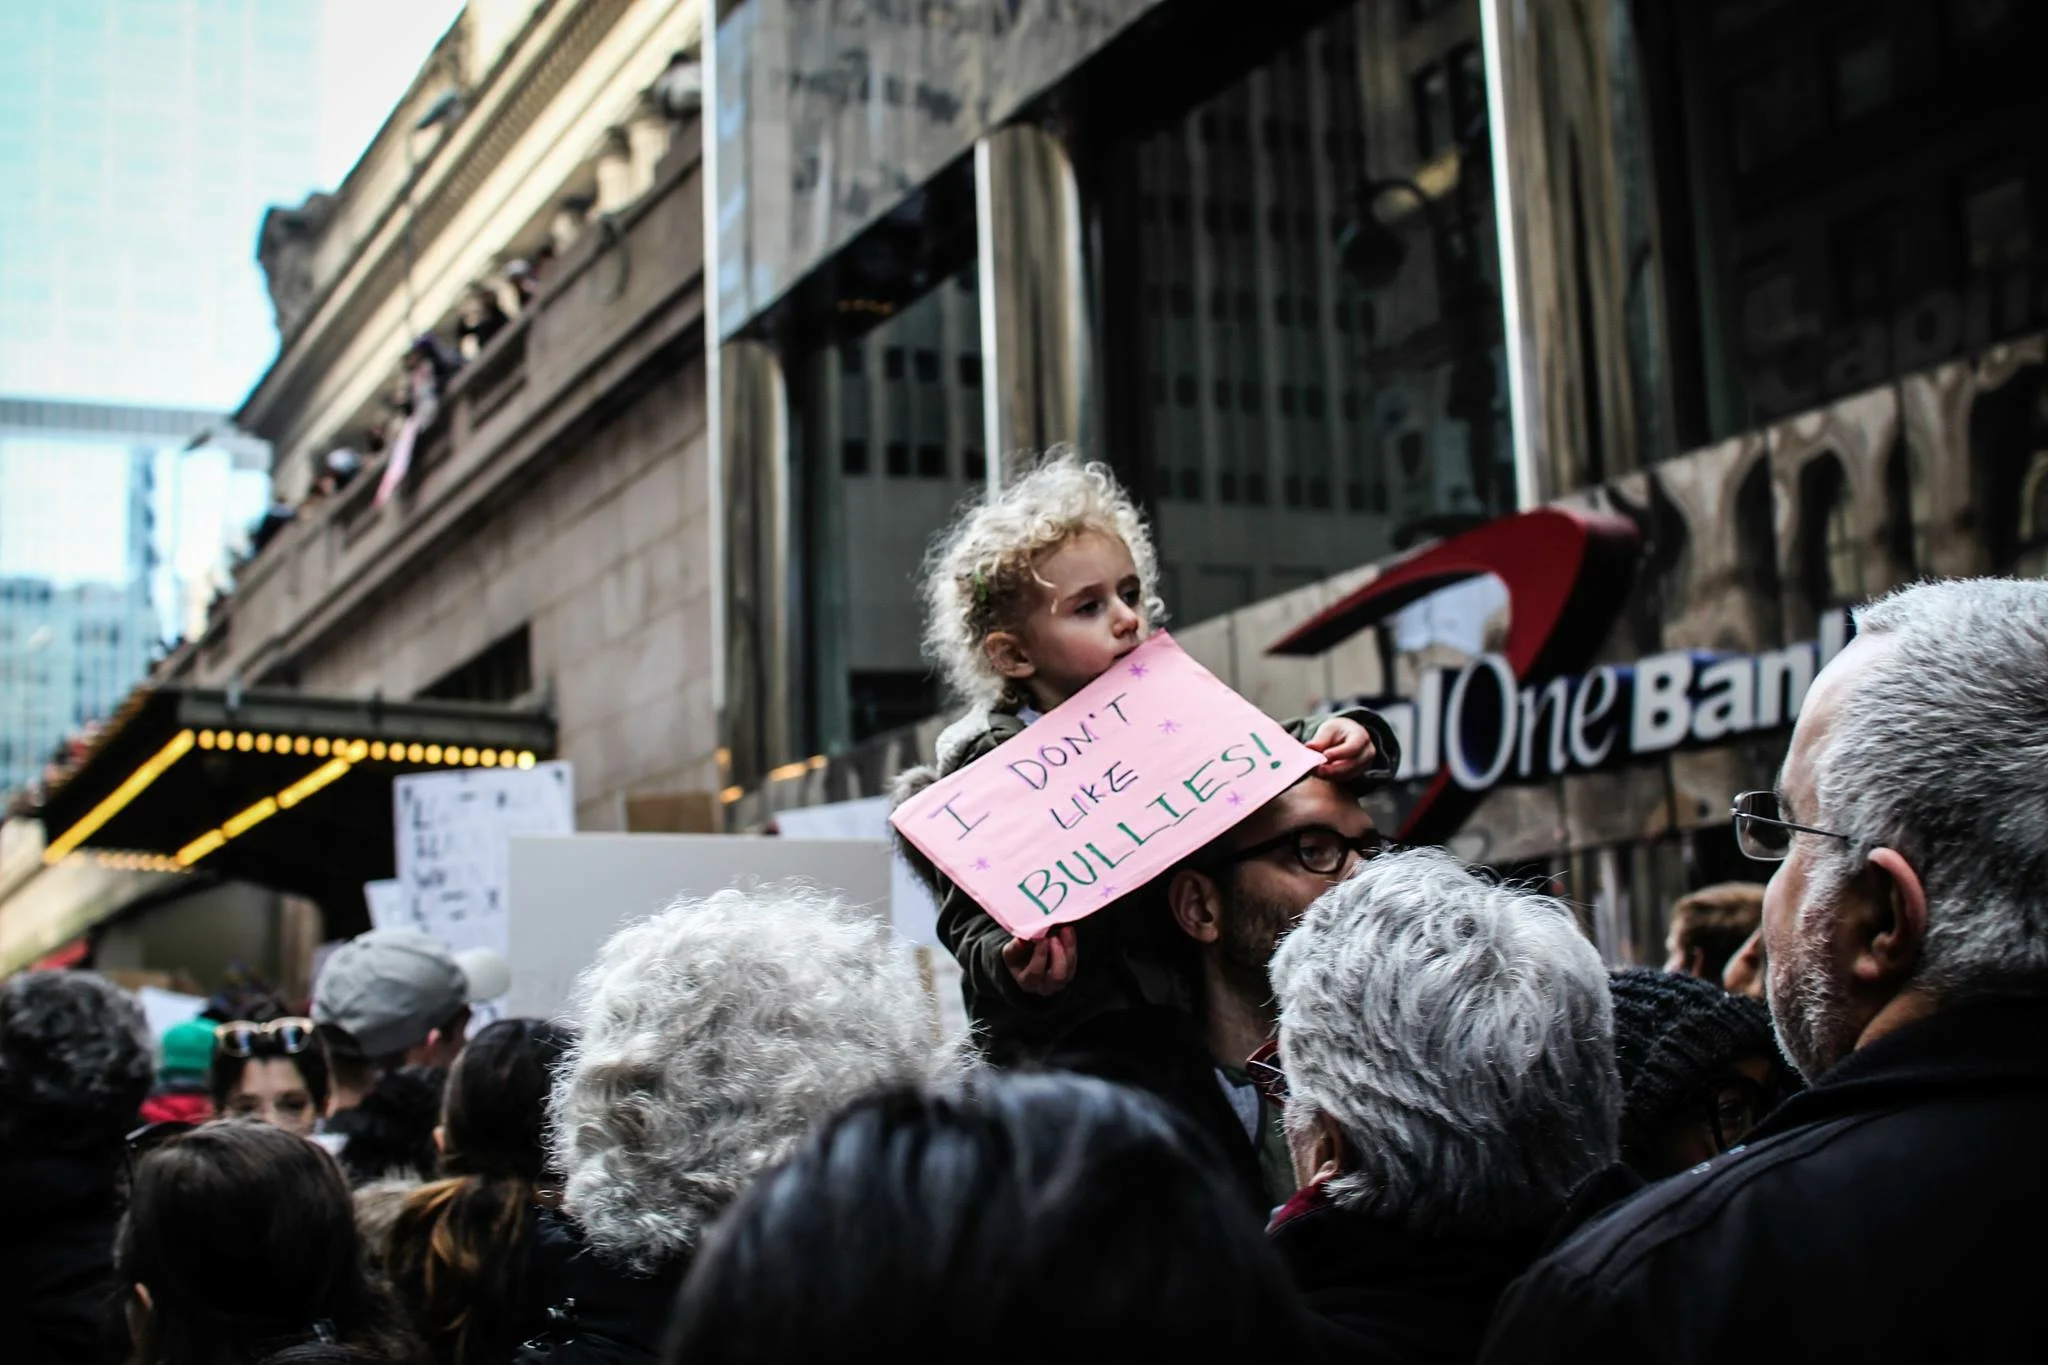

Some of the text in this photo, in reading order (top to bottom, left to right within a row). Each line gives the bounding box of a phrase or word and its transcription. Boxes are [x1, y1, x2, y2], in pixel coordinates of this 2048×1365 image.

[929, 693, 1130, 840] I DON'T
[1016, 731, 1281, 916] BULLIES!
[1050, 760, 1139, 830] LIKE
